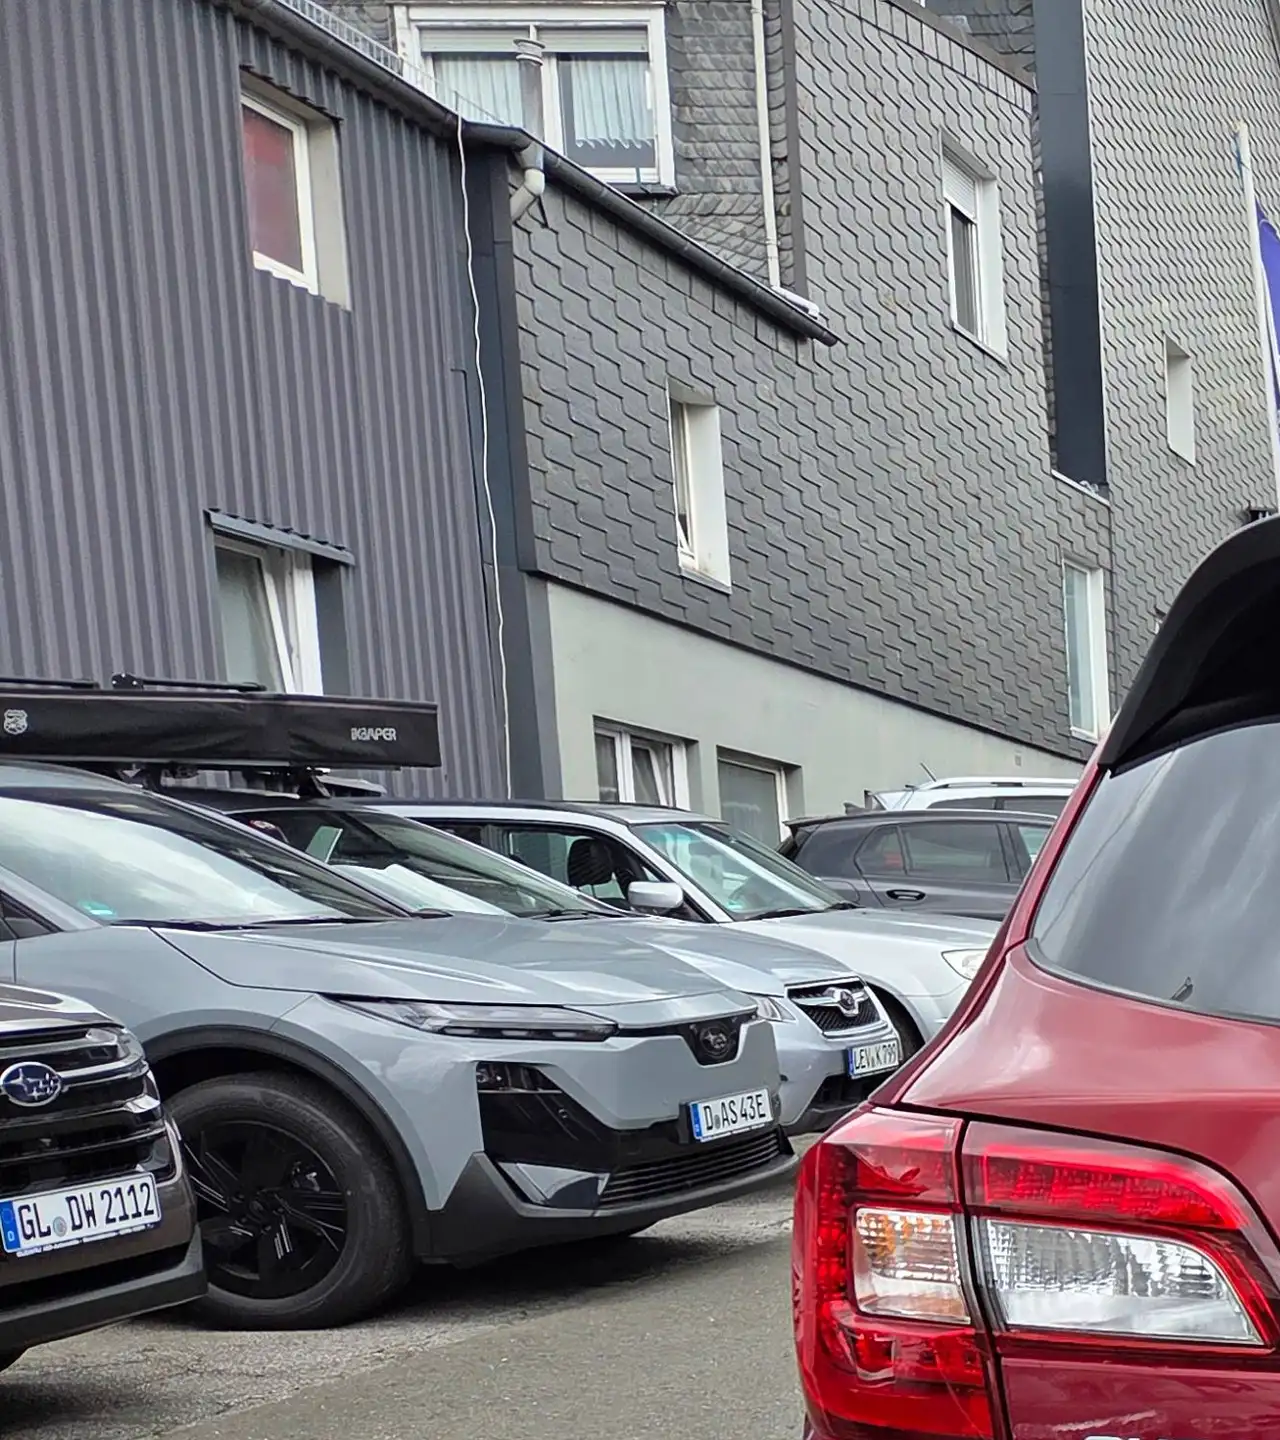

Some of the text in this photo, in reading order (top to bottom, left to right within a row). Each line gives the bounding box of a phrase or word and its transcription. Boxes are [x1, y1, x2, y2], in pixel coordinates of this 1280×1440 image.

[703, 1105, 714, 1130] D
[721, 1100, 739, 1128] AS
[740, 1094, 766, 1122] 43E
[17, 1182, 154, 1241] GL DW 2112
